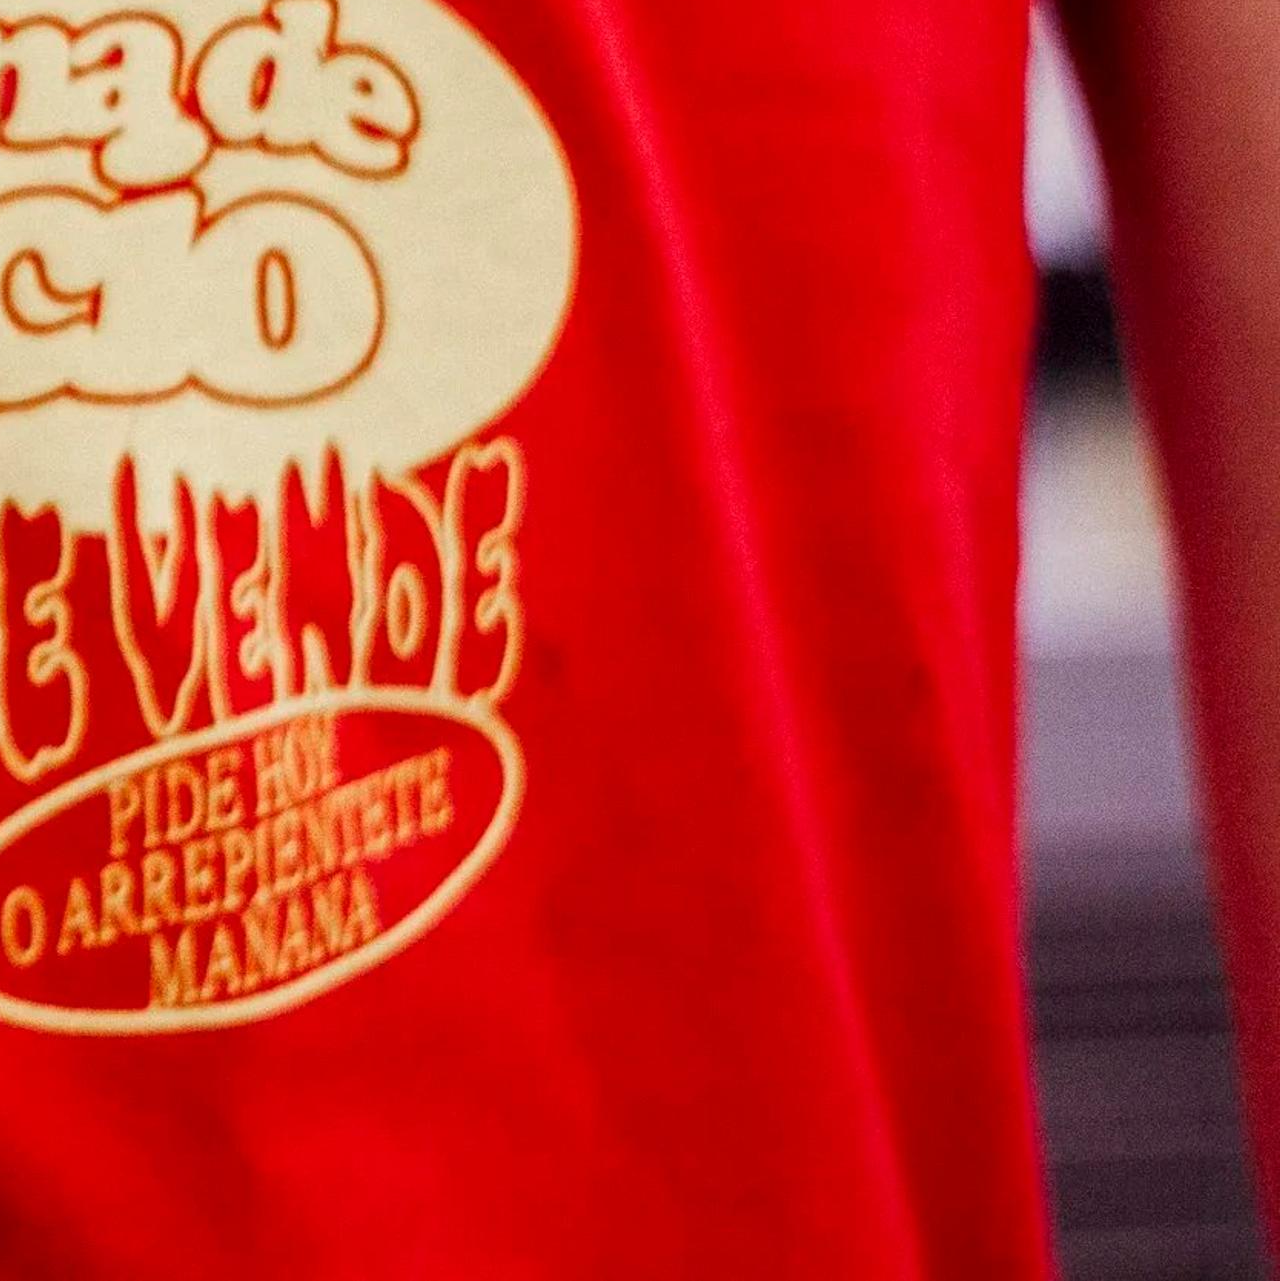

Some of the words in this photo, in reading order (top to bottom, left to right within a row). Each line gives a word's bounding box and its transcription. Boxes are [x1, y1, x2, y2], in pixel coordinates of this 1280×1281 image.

[105, 434, 526, 738] VENDE
[107, 742, 243, 858] PIDE
[252, 710, 341, 817] HOY
[0, 884, 45, 968] O
